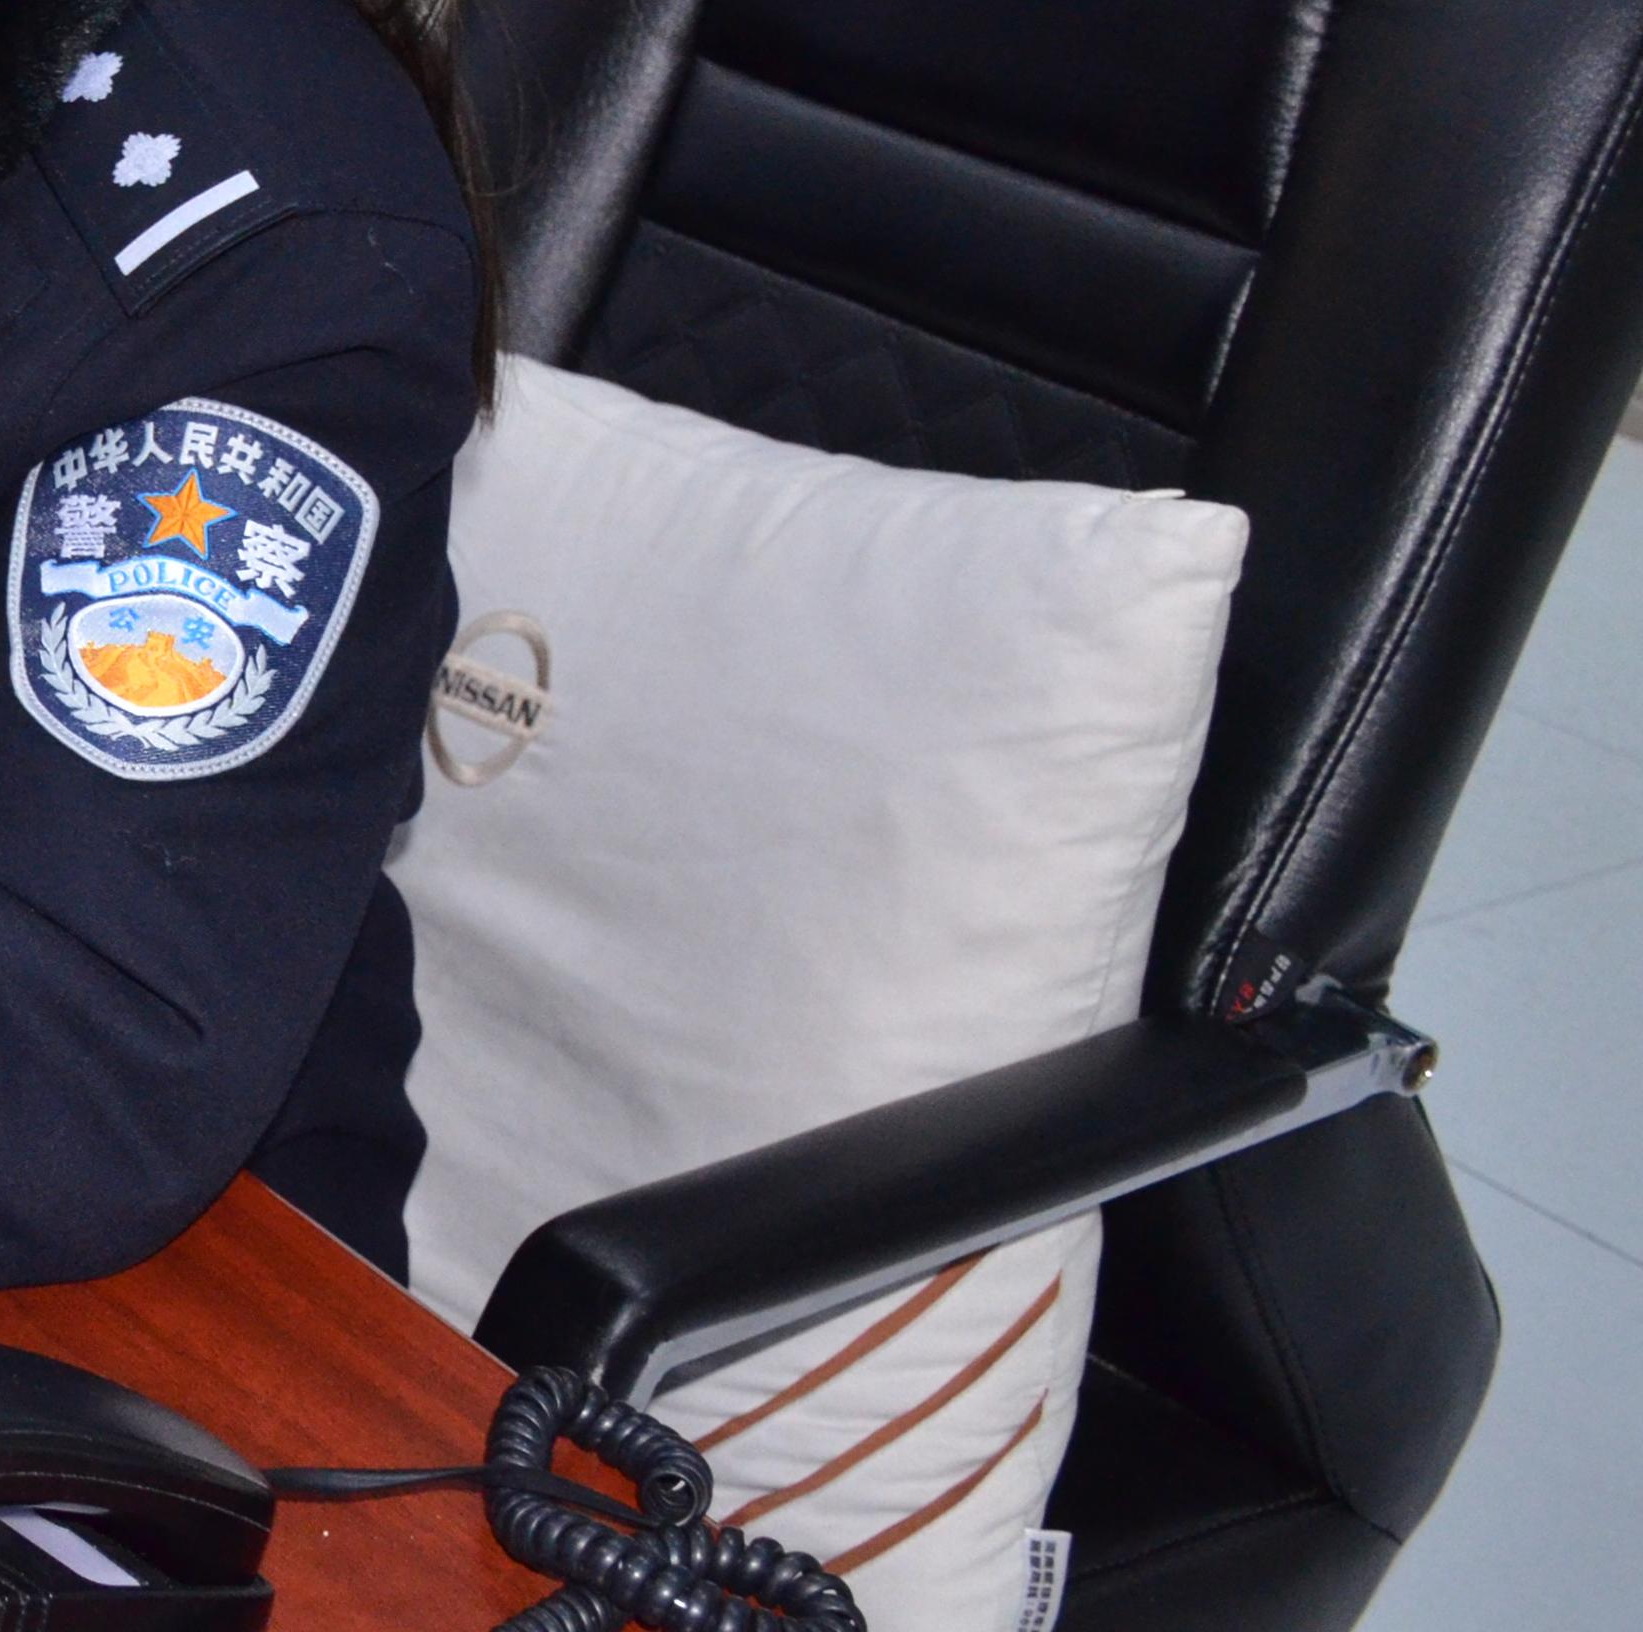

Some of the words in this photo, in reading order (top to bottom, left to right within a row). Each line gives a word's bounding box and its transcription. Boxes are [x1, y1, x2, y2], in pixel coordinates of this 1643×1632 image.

[52, 421, 345, 545] 中华人民共和国
[107, 566, 237, 614] POLICE
[432, 665, 542, 729] NISSAN
